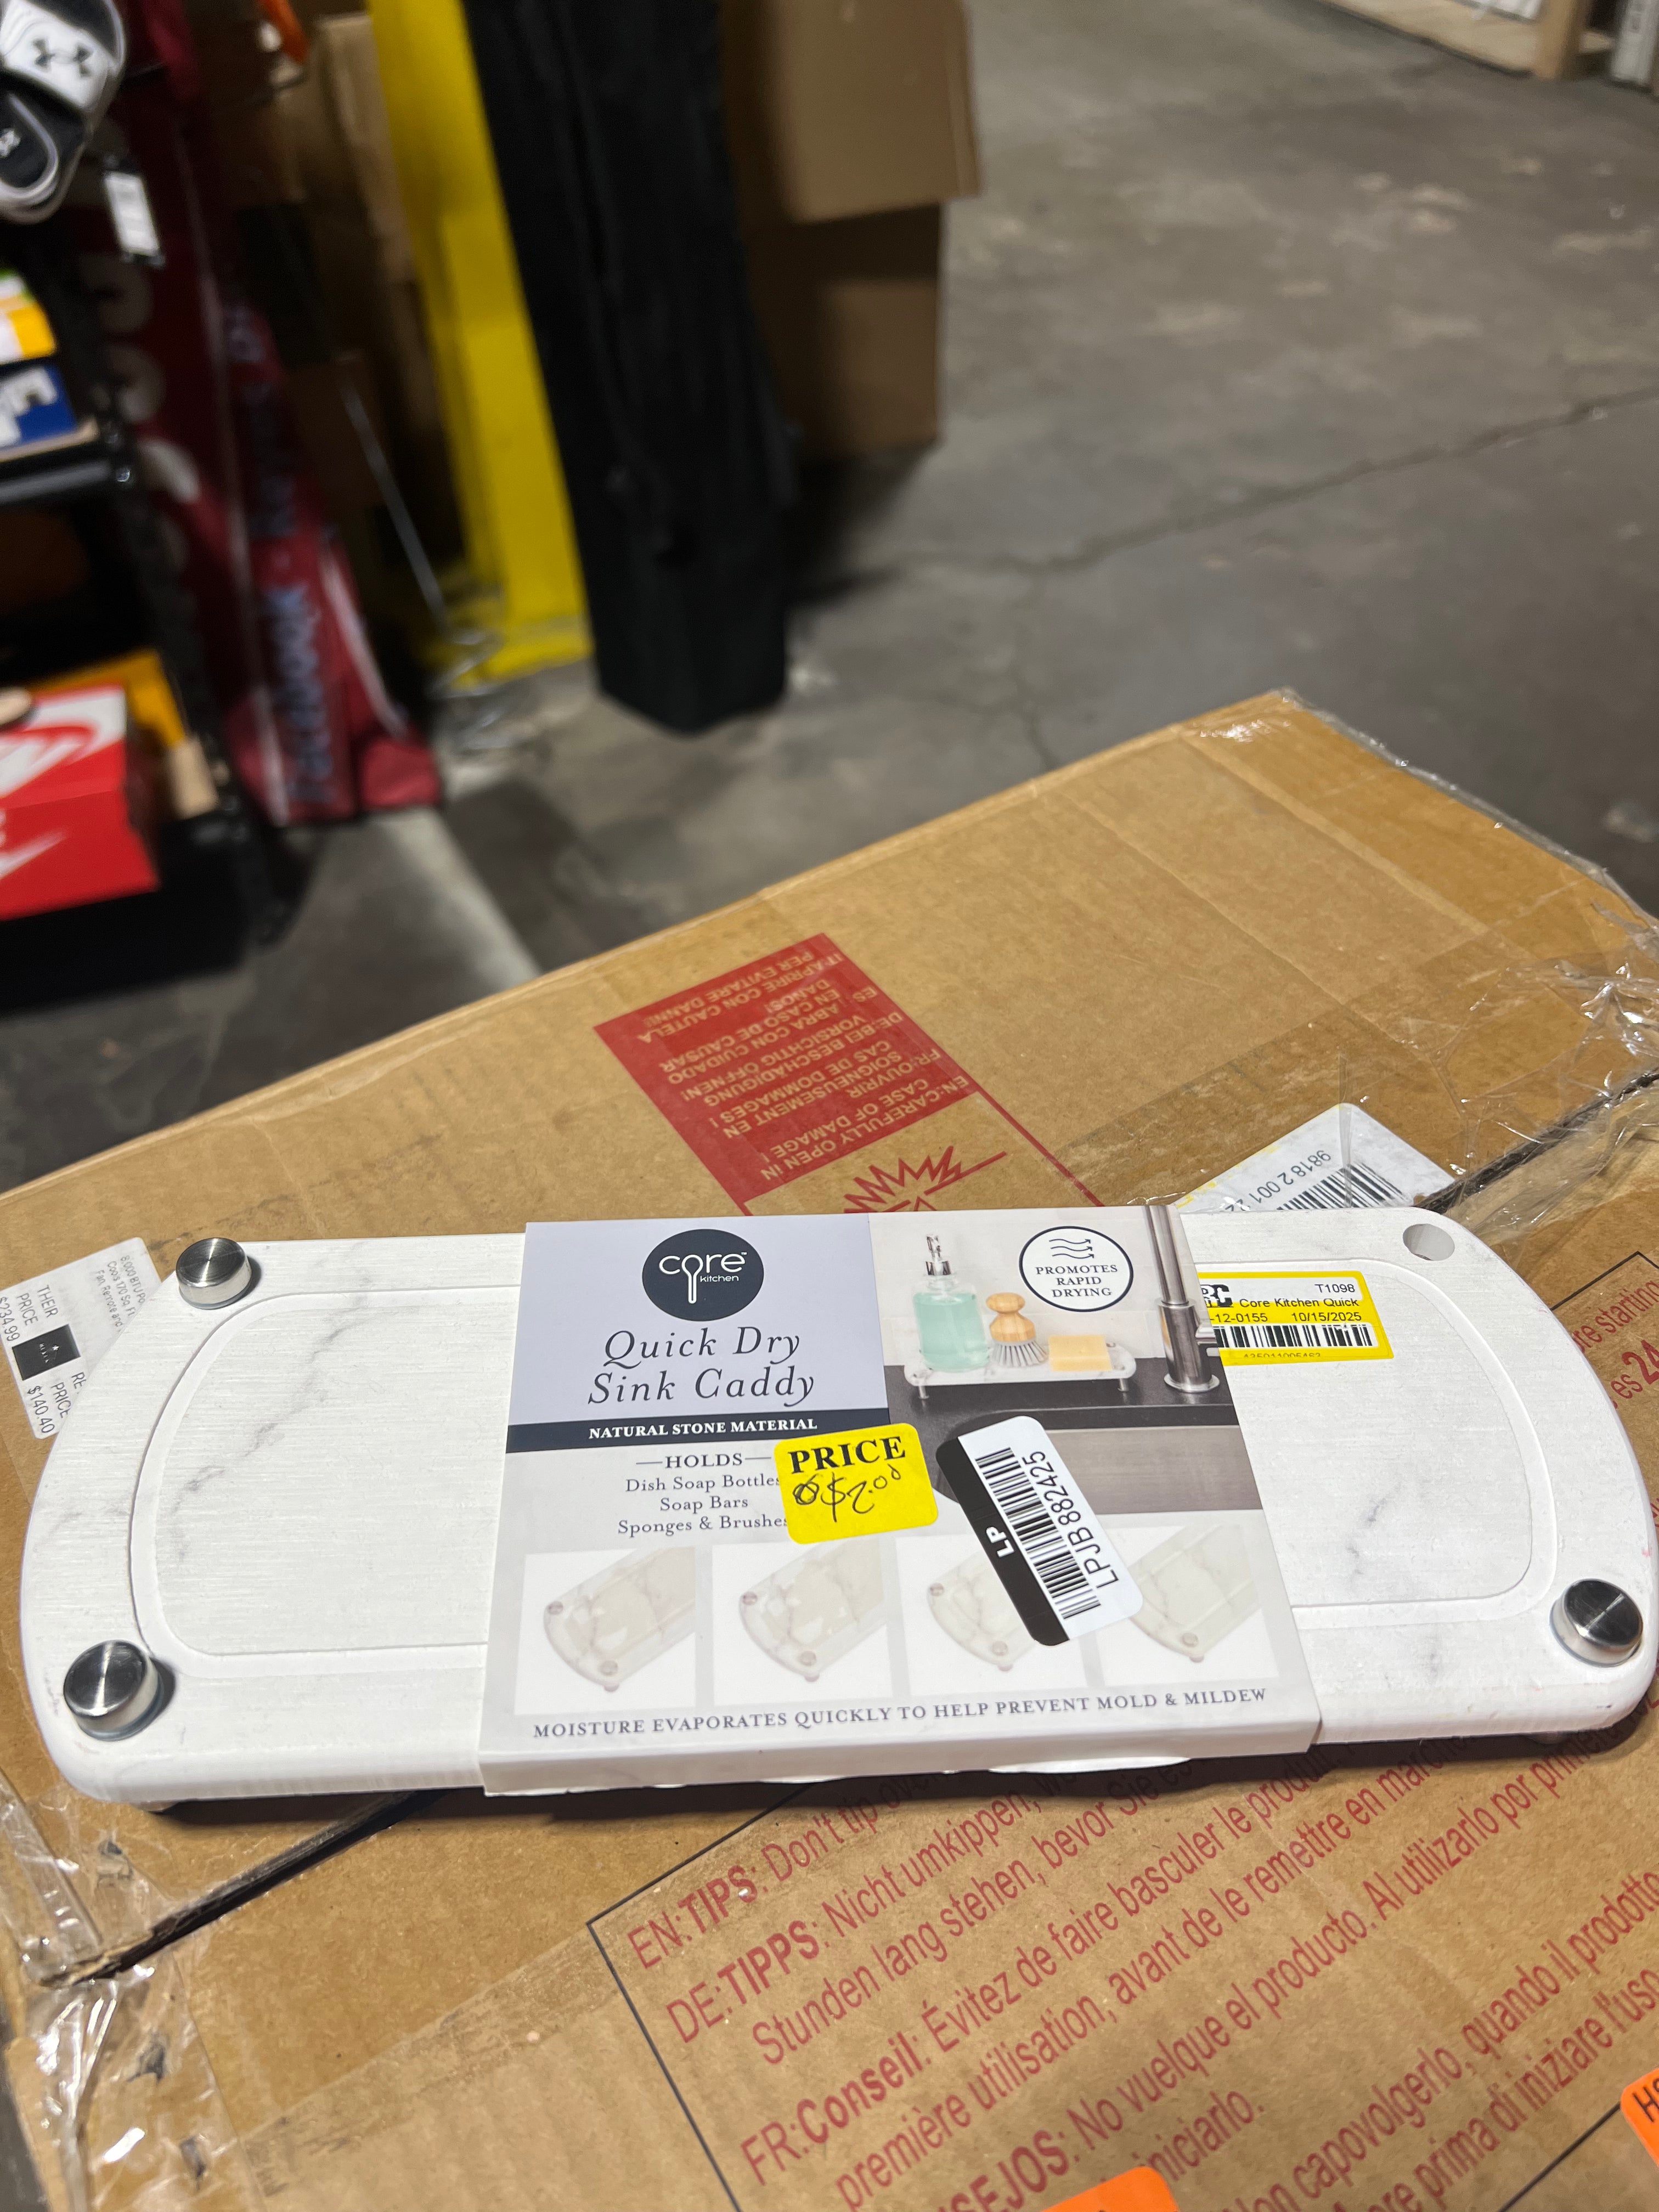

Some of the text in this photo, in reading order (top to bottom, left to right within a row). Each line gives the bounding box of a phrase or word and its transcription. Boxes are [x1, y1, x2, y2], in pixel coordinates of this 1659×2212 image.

[776, 951, 814, 971] PER
[705, 966, 777, 1003] EVITARE
[722, 988, 761, 1009] CON
[636, 1005, 721, 1043] CAUTELA
[658, 989, 840, 1073] EN CASO DE CAUSAR
[751, 1026, 790, 1049] CON
[760, 1015, 866, 1065] VORSICHTIG
[668, 1045, 748, 1084] CUIDADO
[824, 1059, 853, 1075] DE
[853, 1040, 890, 1062] CAS
[720, 1071, 825, 1122] DOMMAGES
[723, 1052, 901, 1138] SOIGNEUSEMENT EN
[878, 1079, 928, 1107] CASE
[854, 1103, 878, 1121] OF
[770, 1115, 851, 1158] DAMAGE
[783, 1140, 836, 1169] OPEN
[1291, 1150, 1331, 1177] 9818
[1277, 1172, 1294, 1185] 2
[700, 1274, 739, 1283] kitchen
[1035, 1264, 1118, 1276] PROMOTES
[1056, 1276, 1102, 1286] RAPID
[37, 1285, 59, 1318] THEIR
[1052, 1287, 1112, 1299] DRYING
[1239, 1297, 1359, 1308] Core Kitchen Quick
[1315, 1284, 1355, 1294] T1098
[16, 1293, 38, 1326] PRICE
[1291, 1312, 1362, 1322] 10/15/2025
[603, 1325, 802, 1370] Quick Dry
[50, 1382, 71, 1418] PRICE
[588, 1364, 815, 1408] Sink Caddy
[1611, 1374, 1643, 1400] es
[27, 1386, 55, 1433] $140.40
[589, 1417, 817, 1440] NATURAL STONE MATERIAL
[665, 1453, 743, 1469] HOLDS
[788, 1436, 906, 1474] PRICE
[625, 1477, 666, 1492] Dish
[673, 1476, 715, 1493] Soap
[660, 1496, 748, 1514] Soap Bars
[1022, 1451, 1119, 1589] LPJB882425
[618, 1519, 692, 1538] Sponges
[699, 1516, 713, 1530] &
[986, 1525, 1014, 1558] LP
[533, 1688, 1267, 1740] MOISTURE EVAPORATES QUICKLY TO HELP PREVENT MOLD & MILDEW
[762, 1819, 845, 1882] Don't
[822, 1865, 906, 1938] Nicht
[908, 1788, 1042, 1888] umkippen,
[753, 1962, 881, 2064] Stunden
[871, 1921, 949, 1982] lang
[940, 1858, 1048, 1938] stehen,
[1031, 1802, 1114, 1869] bevor
[922, 1972, 1022, 2053] Évitez
[1016, 1945, 1057, 1988] de
[1048, 1901, 1119, 1962] faire
[1107, 1822, 1225, 1917] basculer
[1212, 1806, 1252, 1839] le
[1066, 2098, 1124, 2151] No
[1116, 2015, 1231, 2113] vuelque
[1225, 1982, 1261, 2030] el
[1362, 1871, 1405, 1921] Al
[1393, 1807, 1499, 1896] utilizarlo
[1489, 1774, 1539, 1830] por
[836, 2101, 972, 2212] première
[968, 1995, 1117, 2111] utilisation,
[1108, 1926, 1190, 2005] avant
[1182, 1908, 1223, 1949] de
[1209, 1887, 1250, 1923] le
[1243, 1812, 1351, 1902] remettre
[1345, 1787, 1386, 1825] en
[1293, 2048, 1478, 2199] capovolgerlo,
[1462, 1965, 1560, 2060] quando
[1541, 1939, 1581, 1981] il
[1504, 2018, 1613, 2112] iniziare
[1487, 2082, 1528, 2132] di
[1132, 2091, 1265, 2182] niciarlo.
[1413, 2118, 1502, 2212] prima
